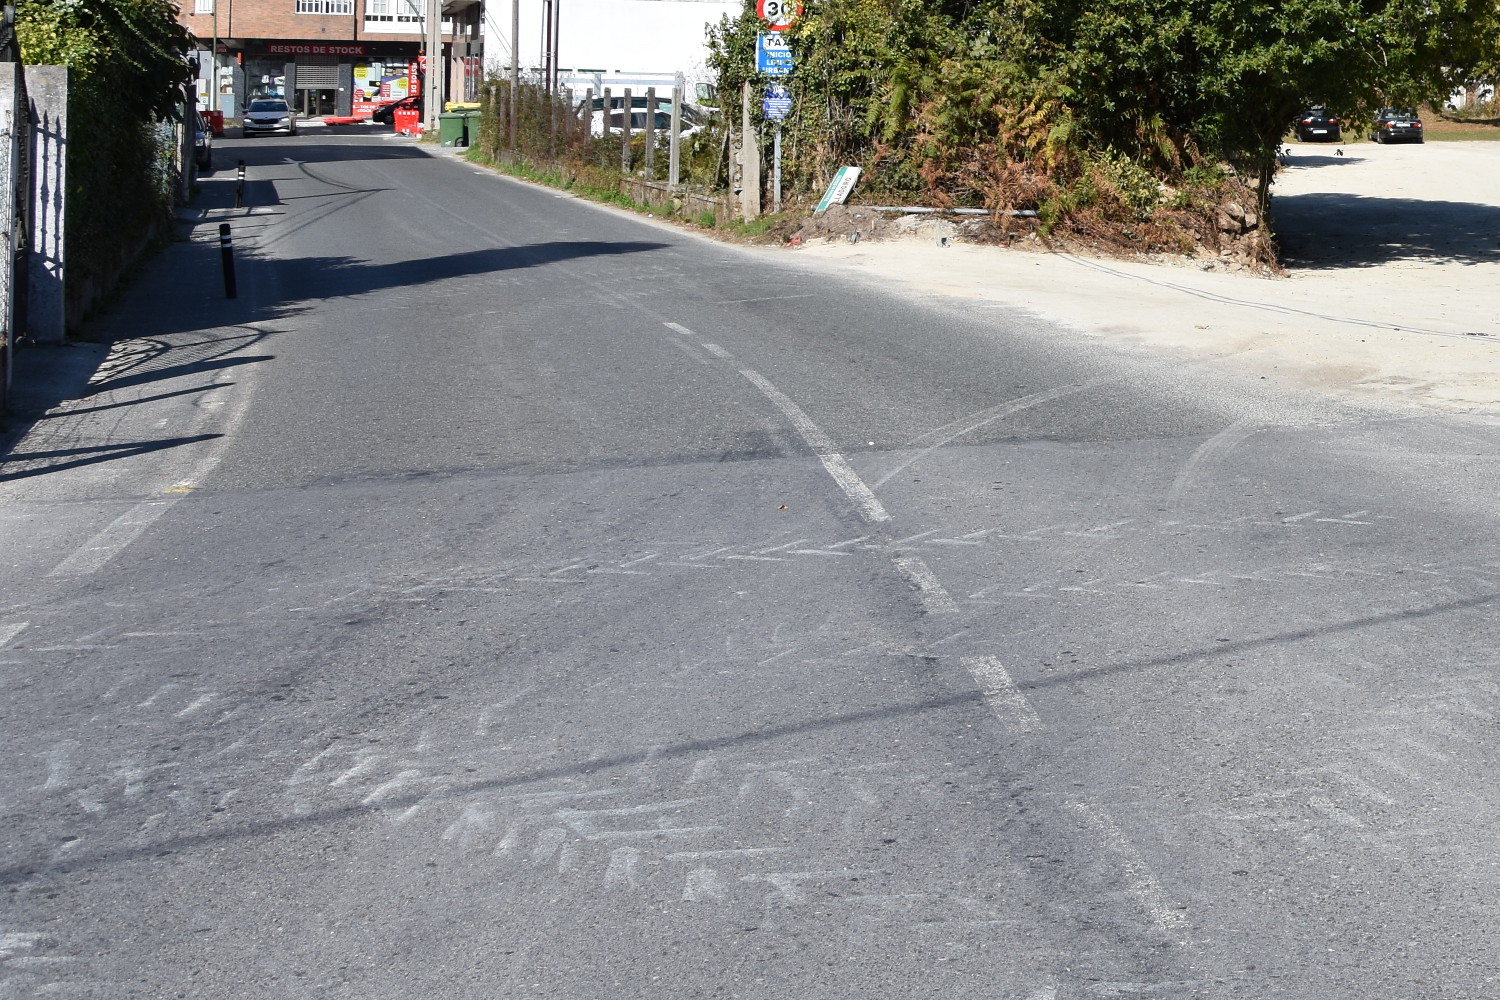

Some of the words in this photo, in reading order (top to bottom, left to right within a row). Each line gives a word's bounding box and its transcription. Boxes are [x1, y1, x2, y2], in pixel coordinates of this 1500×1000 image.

[270, 45, 310, 53] RESTOS
[313, 46, 326, 54] DE
[329, 46, 363, 54] STOCK
